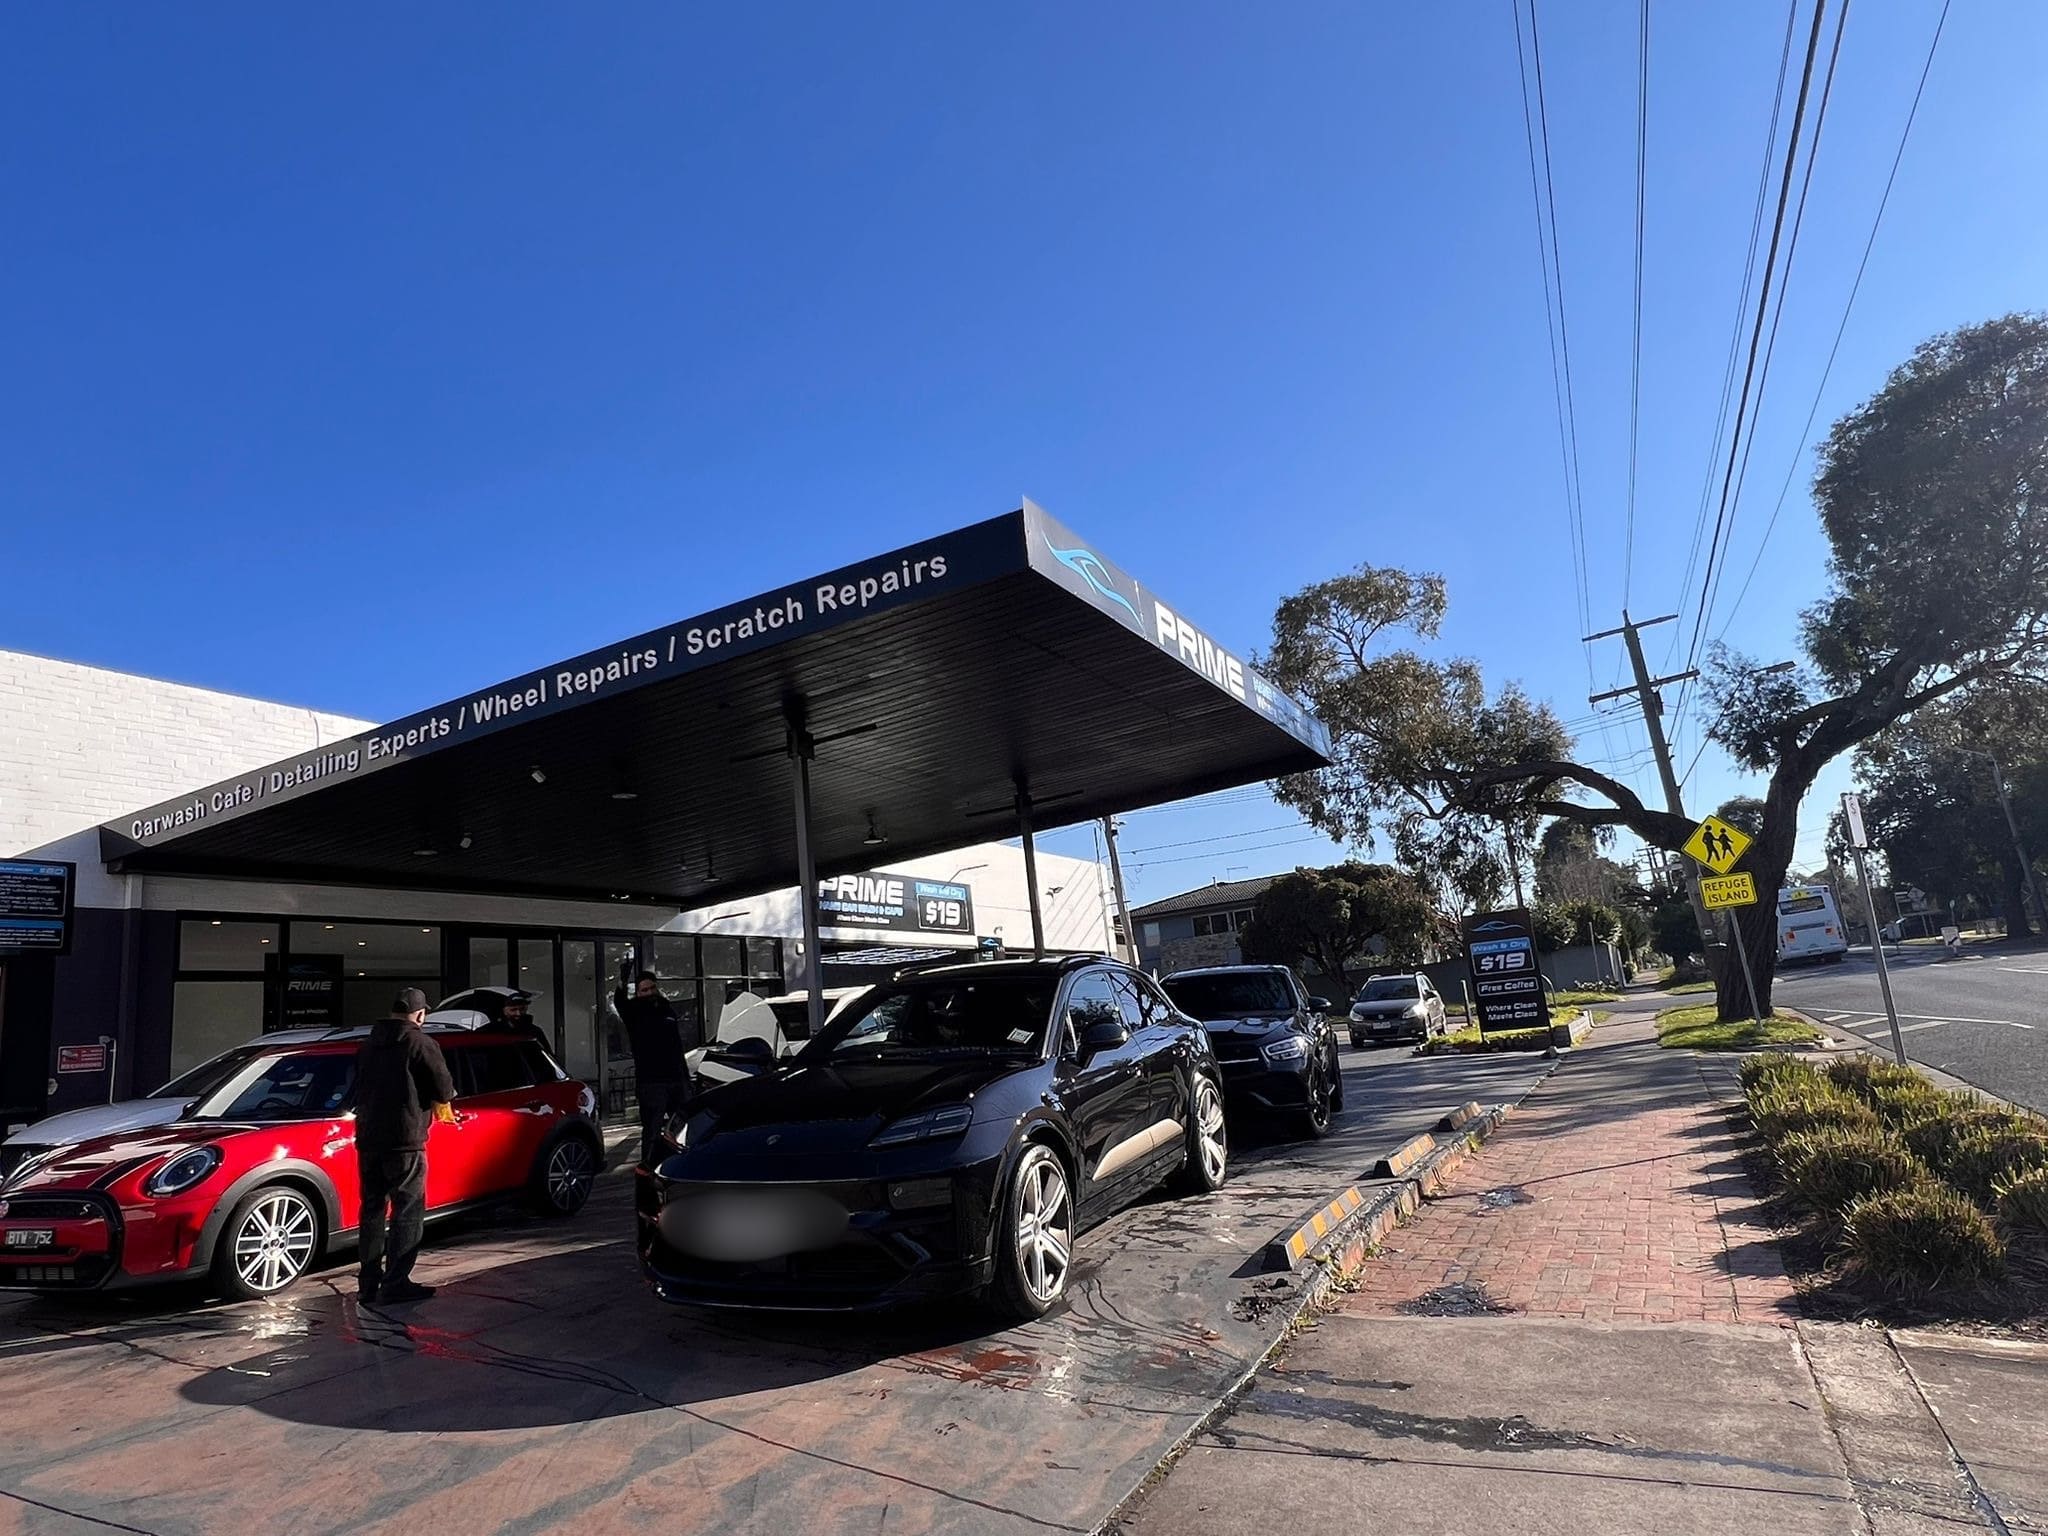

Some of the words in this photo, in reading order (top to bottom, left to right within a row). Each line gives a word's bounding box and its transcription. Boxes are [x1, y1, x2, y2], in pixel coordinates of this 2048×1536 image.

[1154, 600, 1247, 700] PRIME
[131, 801, 206, 841] Carwash
[211, 782, 253, 813] Cafe
[257, 776, 266, 799] /
[270, 747, 360, 793] Detailing
[367, 717, 451, 761] Experts
[458, 705, 467, 731] /
[473, 679, 547, 724] Wheel
[556, 648, 658, 699] Repairs
[668, 636, 676, 663] /
[686, 597, 804, 656] Scratch
[816, 554, 949, 615] Repairs
[818, 874, 904, 906] PRIME
[1704, 877, 1749, 892] REFUGE
[1708, 889, 1749, 903] ISLAND
[926, 900, 961, 926] $19
[1480, 952, 1525, 971] $19
[287, 981, 334, 991] RIME
[1481, 984, 1502, 992] Free
[1504, 981, 1535, 990] Coffee
[1513, 1002, 1538, 1010] Clean
